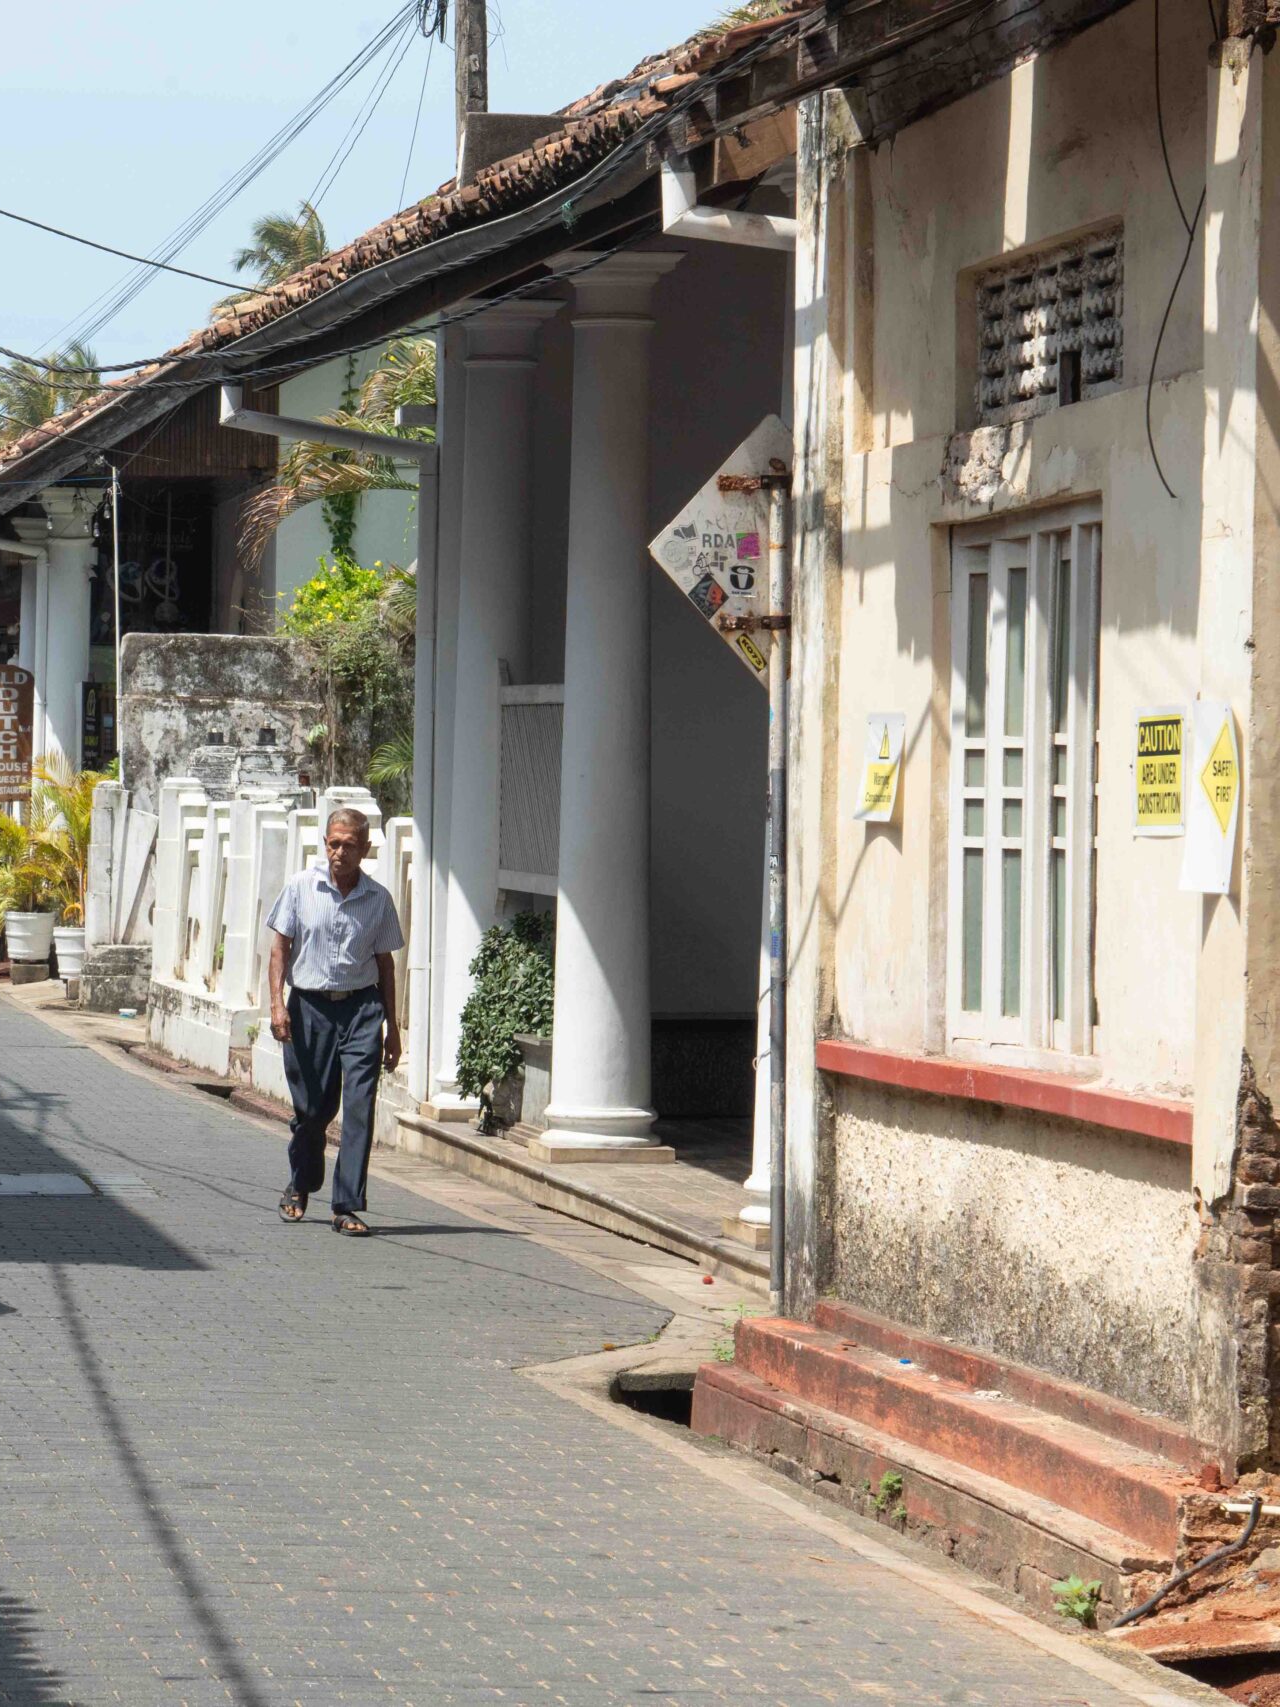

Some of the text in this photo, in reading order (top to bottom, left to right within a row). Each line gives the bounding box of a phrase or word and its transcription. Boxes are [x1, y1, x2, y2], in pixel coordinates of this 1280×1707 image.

[702, 533, 735, 549] RDA
[1138, 724, 1181, 752] CAUTION
[1142, 762, 1176, 785] AREA UNDER
[1138, 792, 1181, 814] CONSTRUCTION
